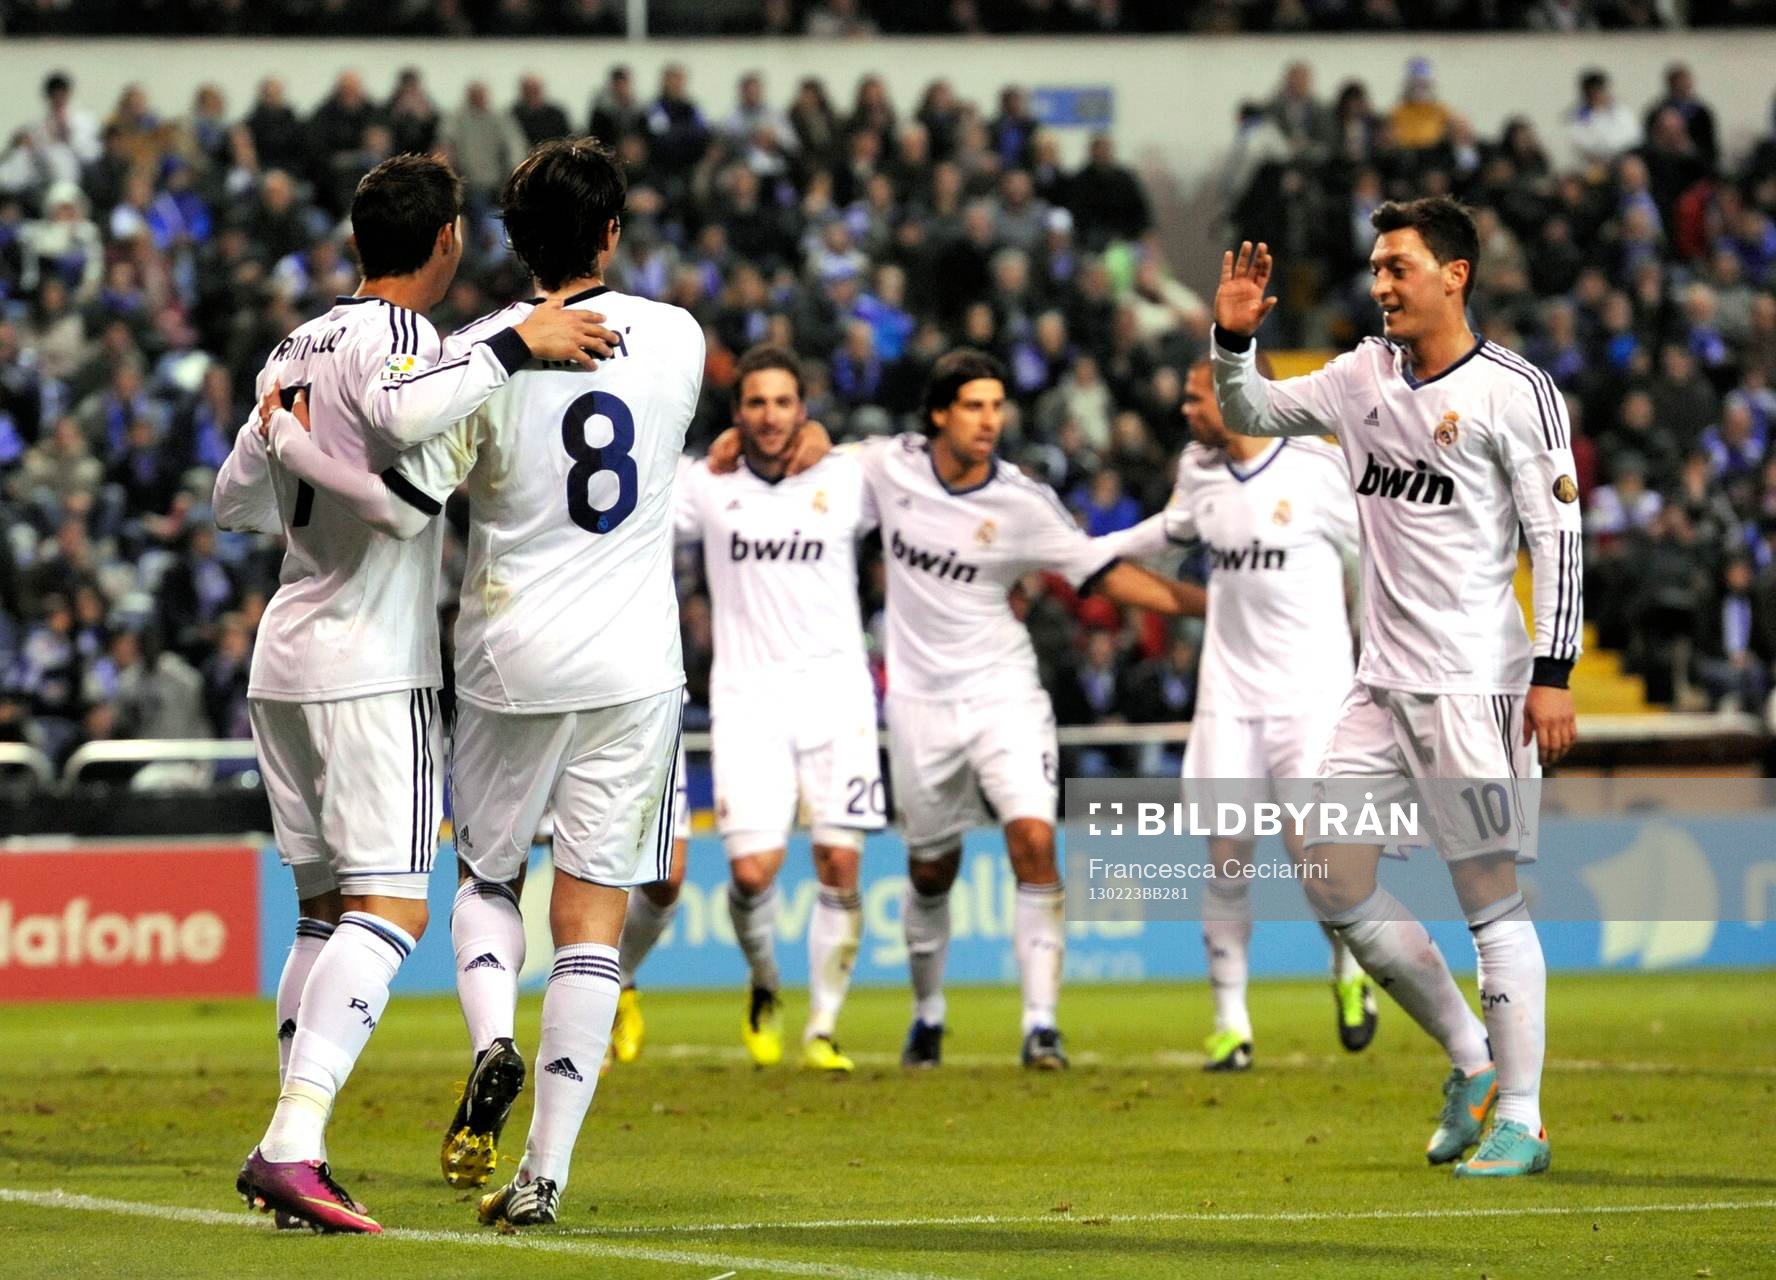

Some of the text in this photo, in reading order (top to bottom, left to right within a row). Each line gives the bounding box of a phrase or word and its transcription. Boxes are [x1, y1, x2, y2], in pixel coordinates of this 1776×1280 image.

[561, 390, 639, 535] 8
[1357, 453, 1455, 506] bwin
[730, 530, 824, 561] bwin
[891, 530, 982, 584] bwin
[847, 776, 886, 815] 20
[1461, 782, 1512, 841] 10
[0, 896, 227, 968] afone
